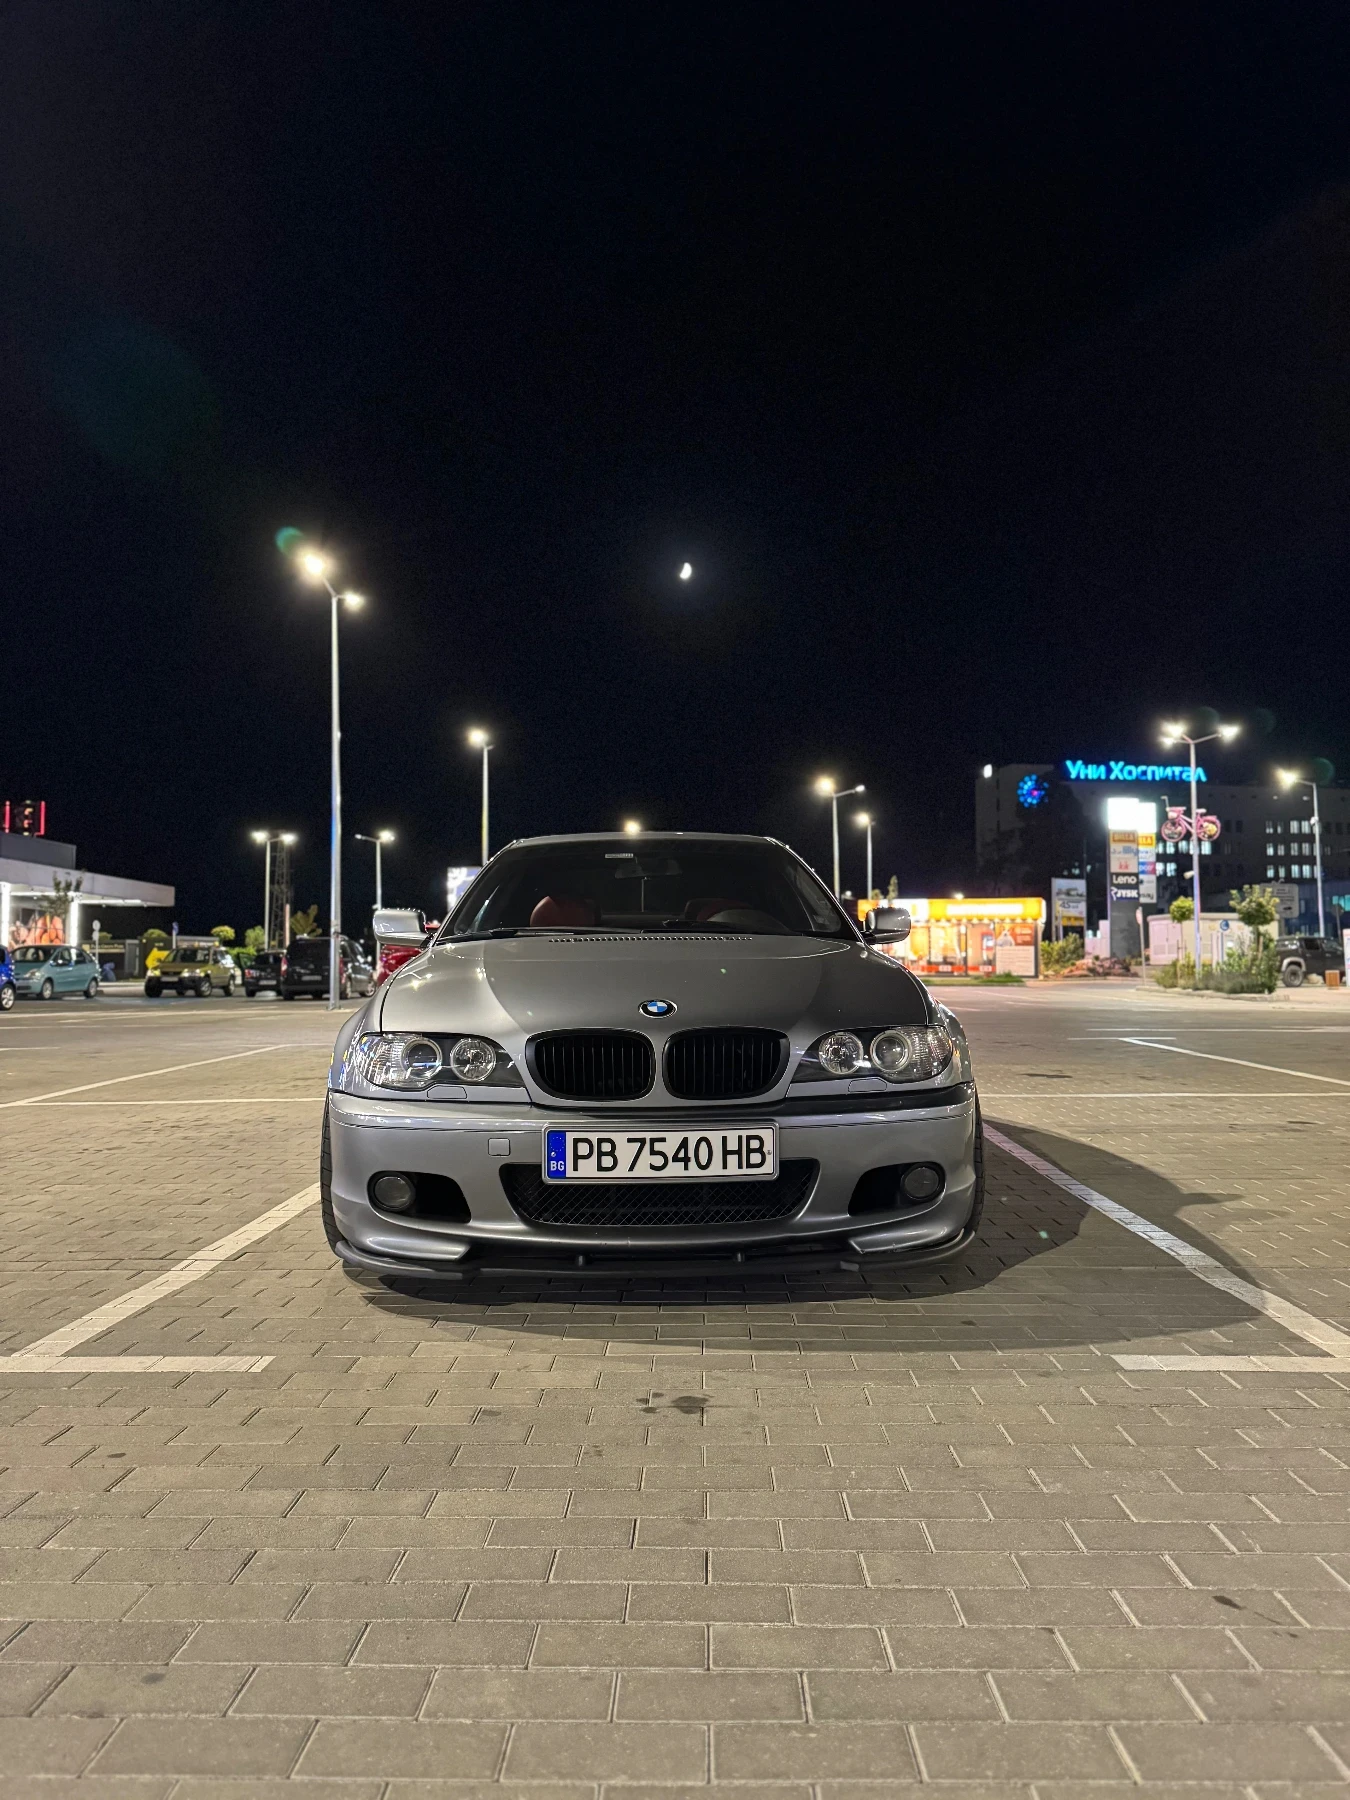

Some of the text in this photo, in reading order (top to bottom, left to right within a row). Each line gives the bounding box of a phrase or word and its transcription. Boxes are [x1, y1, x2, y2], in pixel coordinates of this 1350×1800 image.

[1065, 760, 1207, 783] Уни Хоспитал
[1113, 874, 1137, 884] Leno
[1117, 889, 1138, 898] JYSK
[572, 1134, 767, 1172] PB 7540 HB
[550, 1160, 565, 1172] BG
